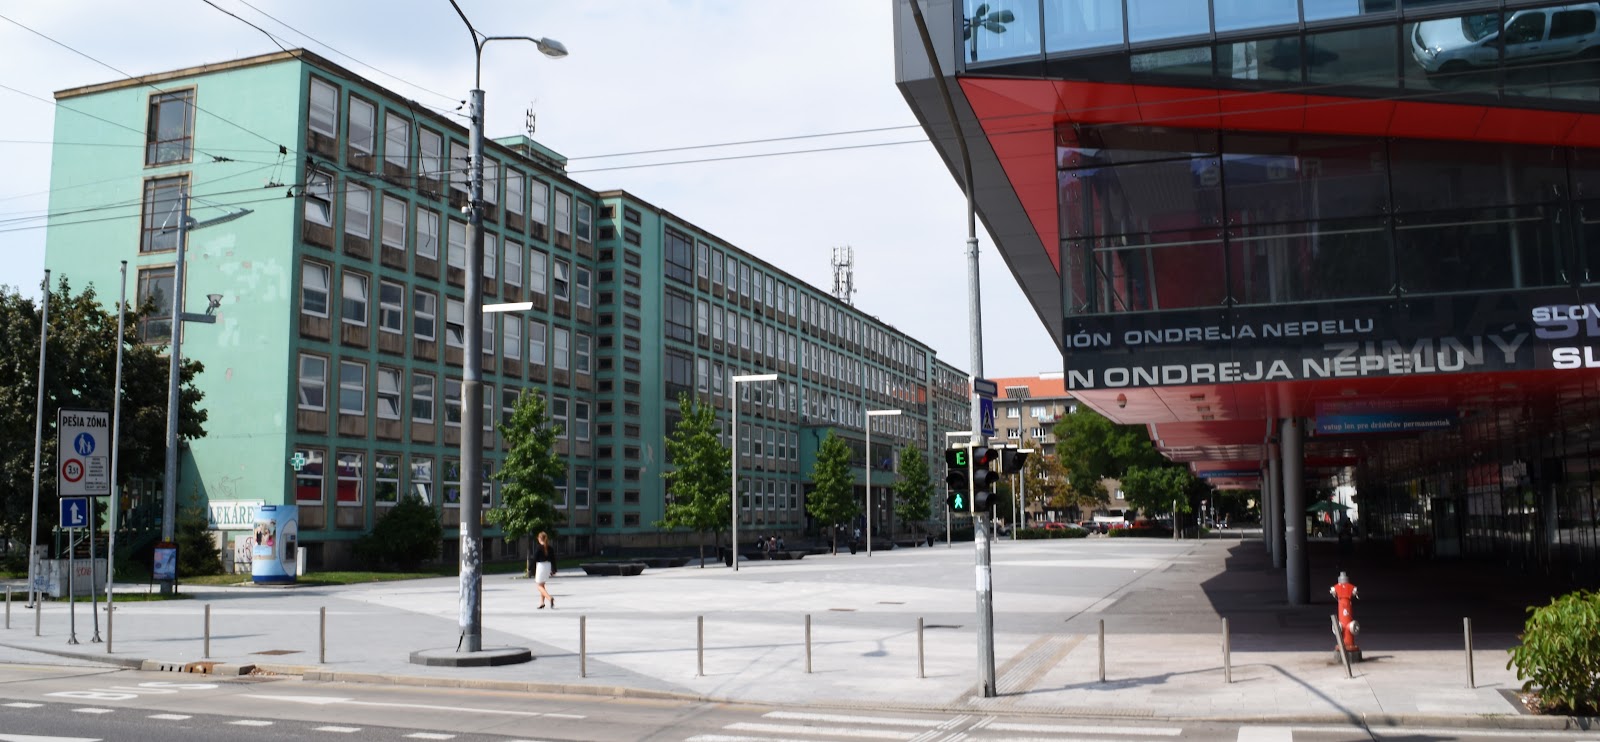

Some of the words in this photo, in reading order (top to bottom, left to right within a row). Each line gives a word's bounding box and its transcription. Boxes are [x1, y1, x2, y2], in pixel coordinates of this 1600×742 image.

[1066, 329, 1111, 348] IÓN
[1124, 325, 1257, 345] ONDREJA
[1262, 318, 1374, 338] NEPELU
[1323, 323, 1529, 371] ZIMNÝ
[1068, 368, 1095, 389] N
[1103, 360, 1294, 387] ONDREJA
[1302, 350, 1465, 379] NEPELU
[62, 414, 85, 427] PEŠIA
[86, 415, 107, 428] ZÓNA
[1323, 422, 1342, 431] vstup
[1344, 421, 1355, 430] len
[1357, 422, 1369, 431] pre
[208, 502, 255, 525] LEKÁRE
[43, 681, 219, 700] BUS
